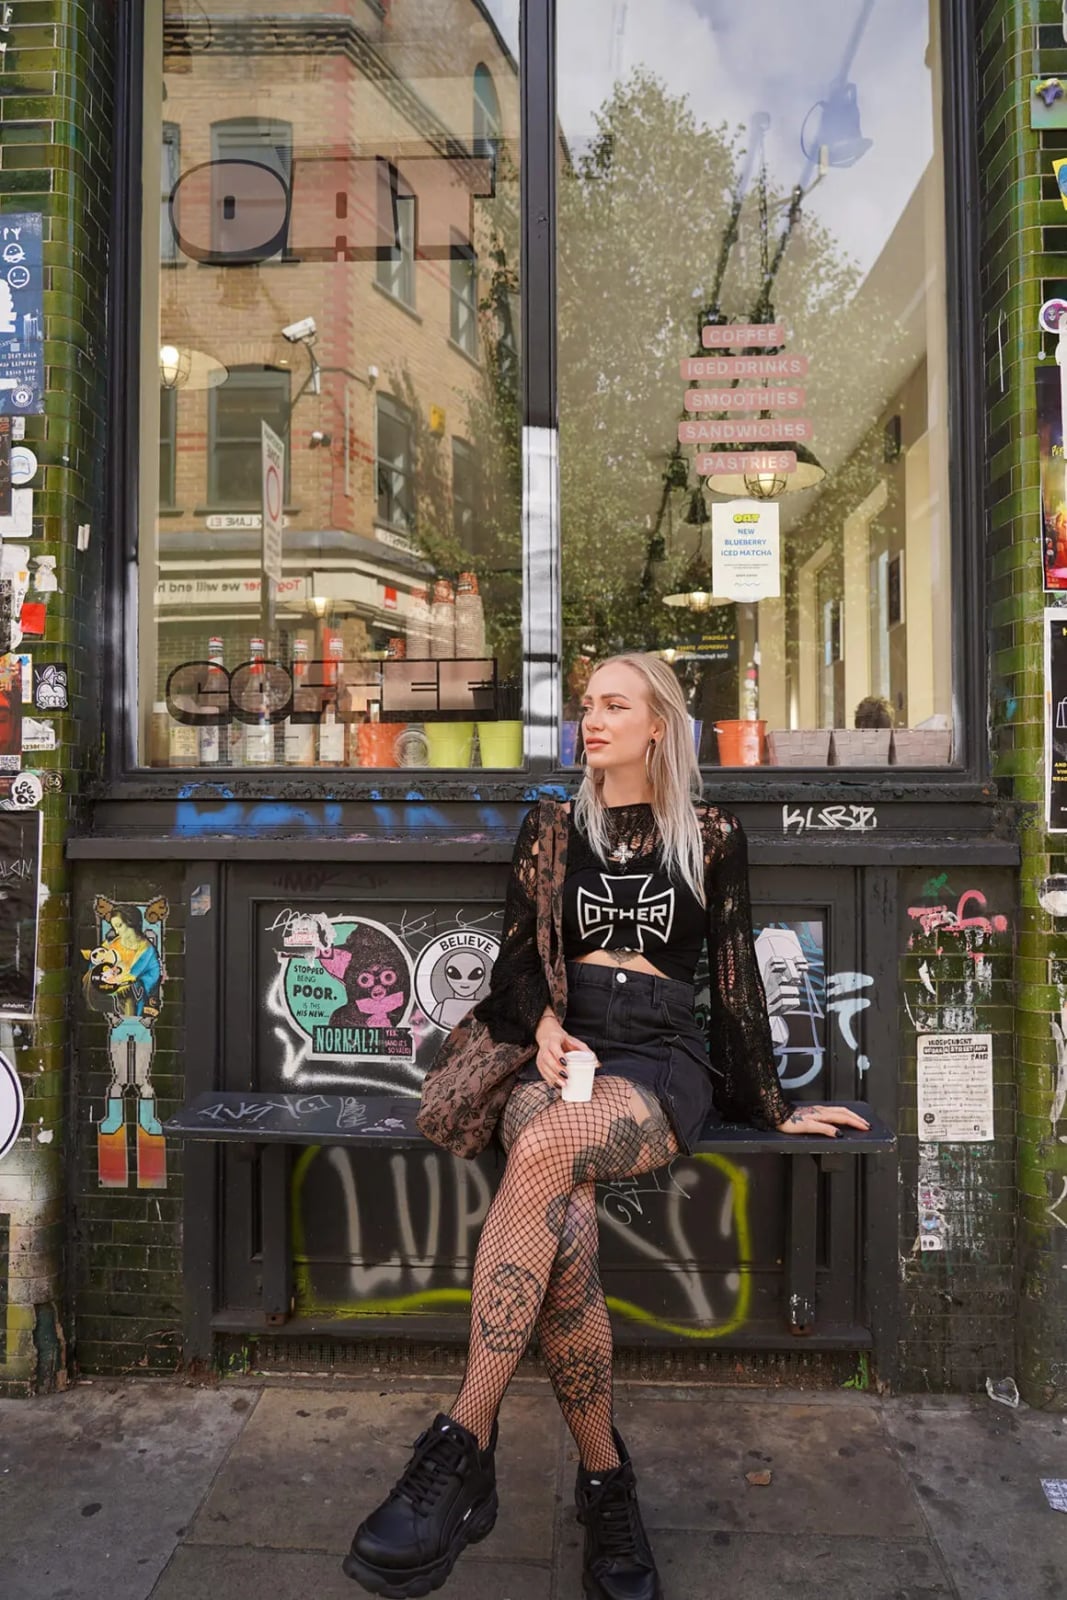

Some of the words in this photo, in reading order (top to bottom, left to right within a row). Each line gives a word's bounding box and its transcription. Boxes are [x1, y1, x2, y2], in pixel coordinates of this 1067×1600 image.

[168, 156, 497, 267] OAT
[709, 328, 777, 343] COFFEE
[687, 361, 729, 375] ICED
[735, 359, 801, 374] DRINKS
[692, 391, 799, 407] SMOOTHIES
[686, 423, 806, 439] SANDWICHES
[703, 456, 790, 470] PASTRIES
[733, 513, 760, 524] OAT
[166, 658, 497, 726] COFFEE
[584, 903, 667, 926] OTHER
[439, 935, 493, 954] BELIEVE
[294, 965, 324, 975] STOPPED
[293, 984, 337, 1000] POOR.
[316, 1027, 379, 1053] NORMAL?!
